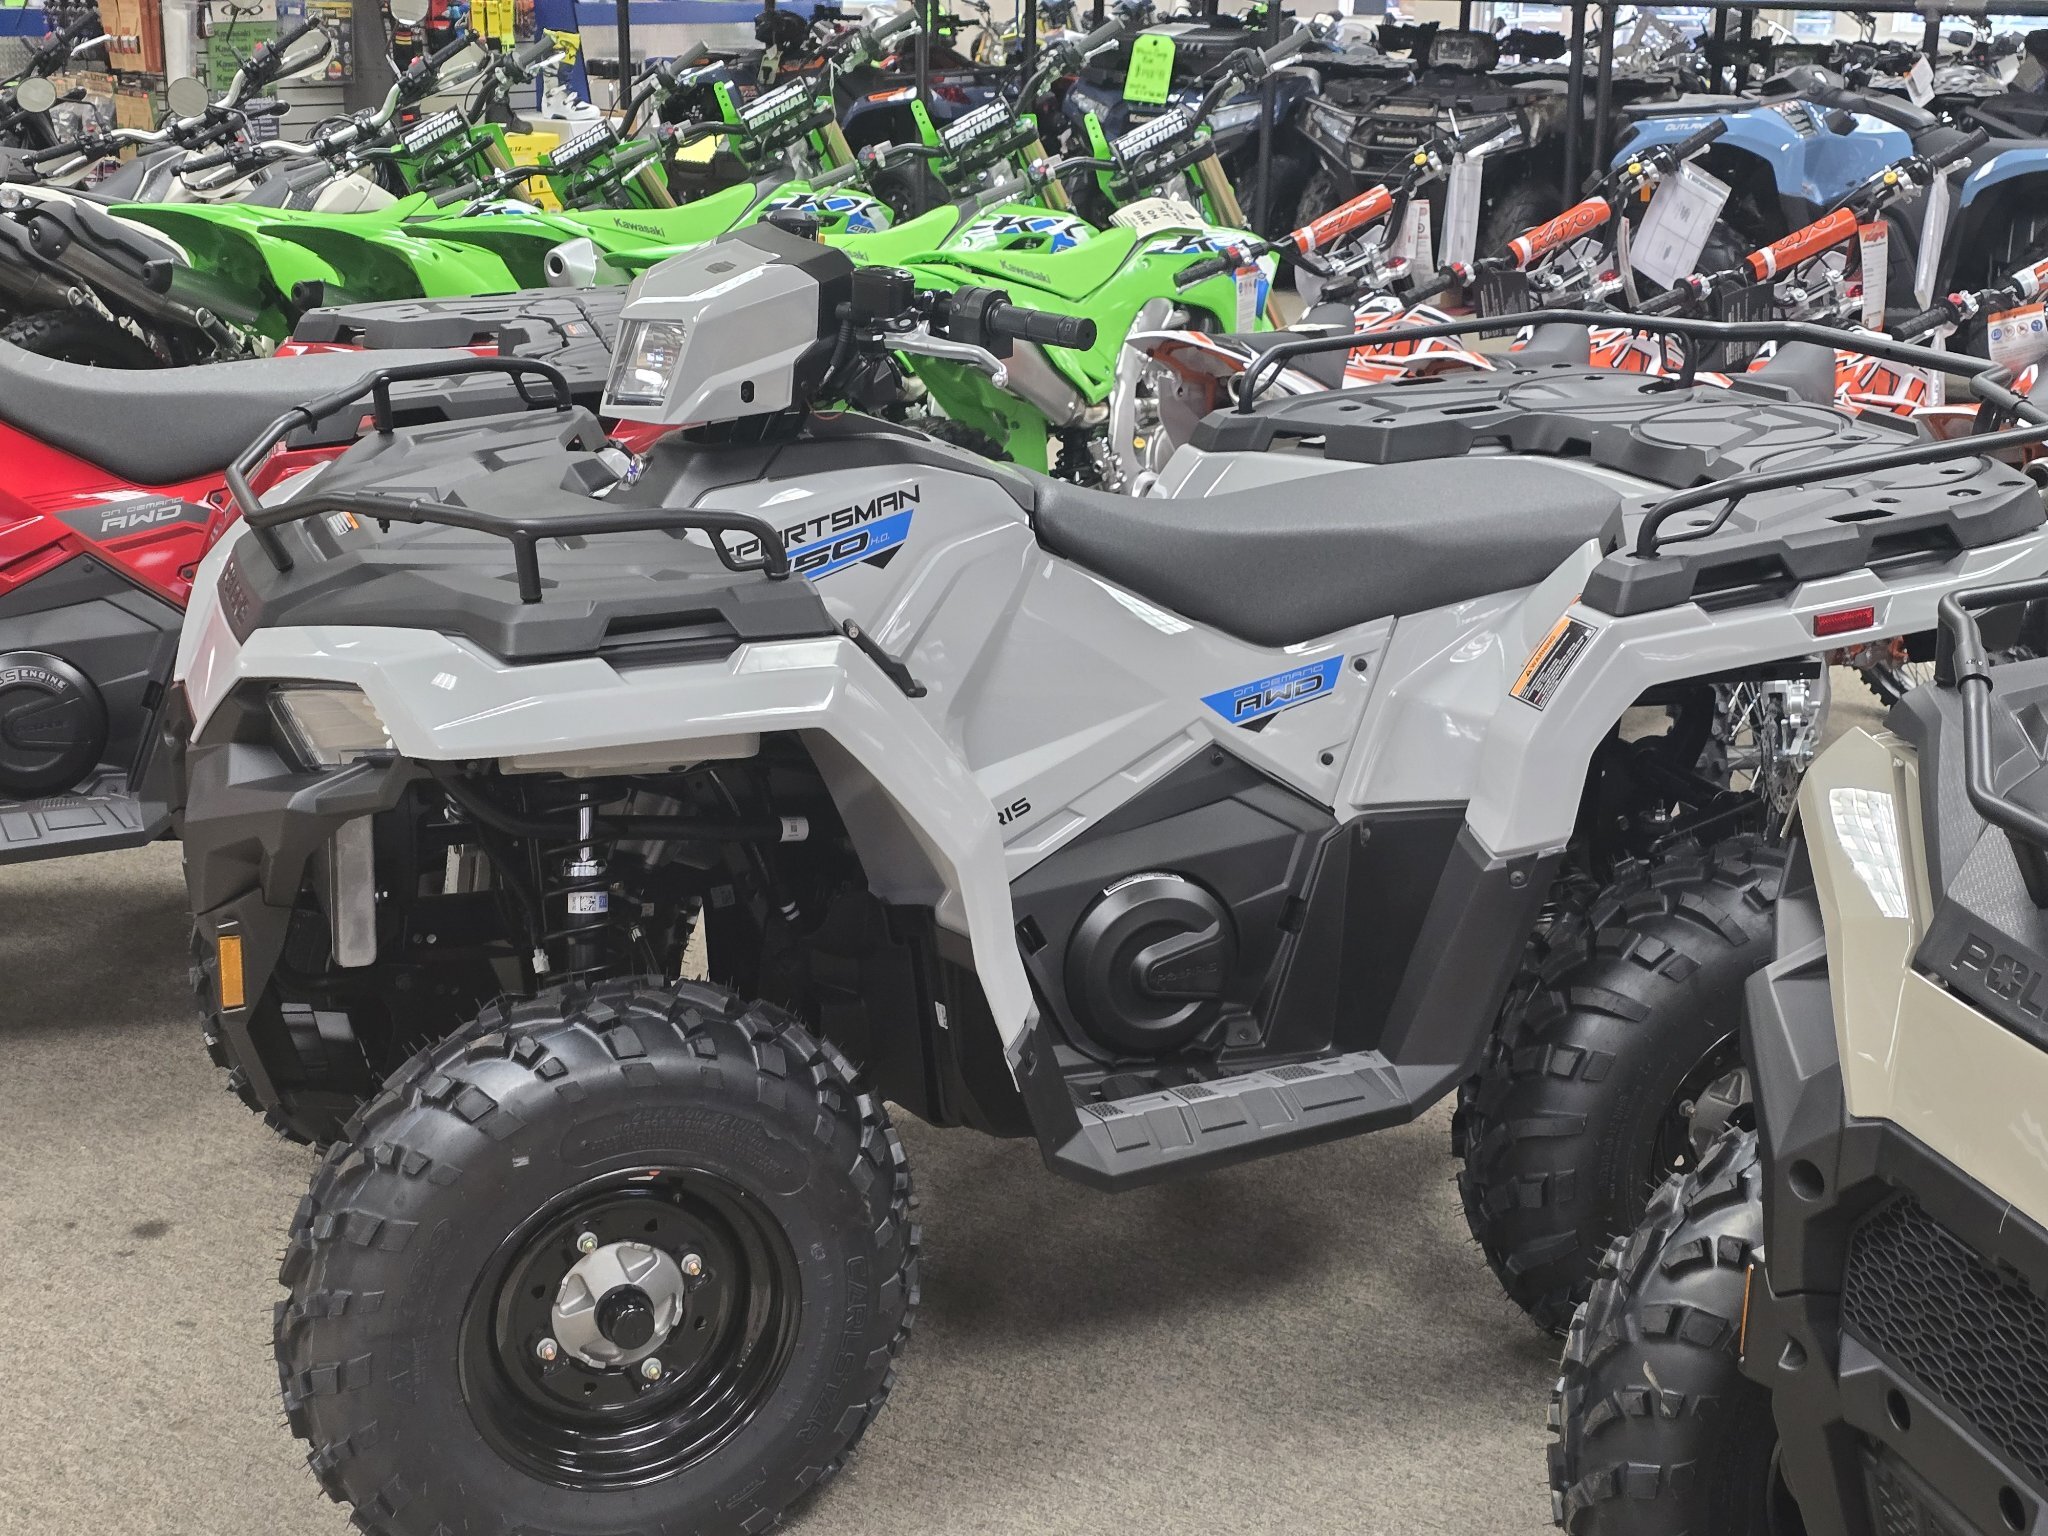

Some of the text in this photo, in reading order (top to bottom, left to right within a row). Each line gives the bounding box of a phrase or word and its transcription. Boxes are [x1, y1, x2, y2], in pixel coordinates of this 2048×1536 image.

[749, 92, 808, 130] RENTHAL
[408, 118, 463, 153] RENTHAL
[552, 122, 606, 157] RENTHAL
[554, 128, 610, 166] RENTHAL
[949, 111, 1009, 149] RENTHAL
[1118, 112, 1183, 150] RENTHAL
[1122, 119, 1188, 160] RENTHAL
[613, 217, 666, 238] Kawasaki
[1133, 210, 1152, 226] BIKE
[1146, 209, 1160, 220] ON
[999, 259, 1053, 284] Kawasaki
[101, 504, 182, 532] AWD
[102, 496, 184, 518] ON DEMAND
[728, 484, 921, 557] PRTSMAN
[787, 530, 870, 573] 50
[1530, 635, 1556, 669] WARNING
[20, 669, 67, 690] ENGINE
[1233, 663, 1324, 698] ON DEMAND
[1233, 674, 1324, 718] AWD
[1949, 932, 2048, 1032] POL
[797, 1256, 867, 1443] CARLSTAR
